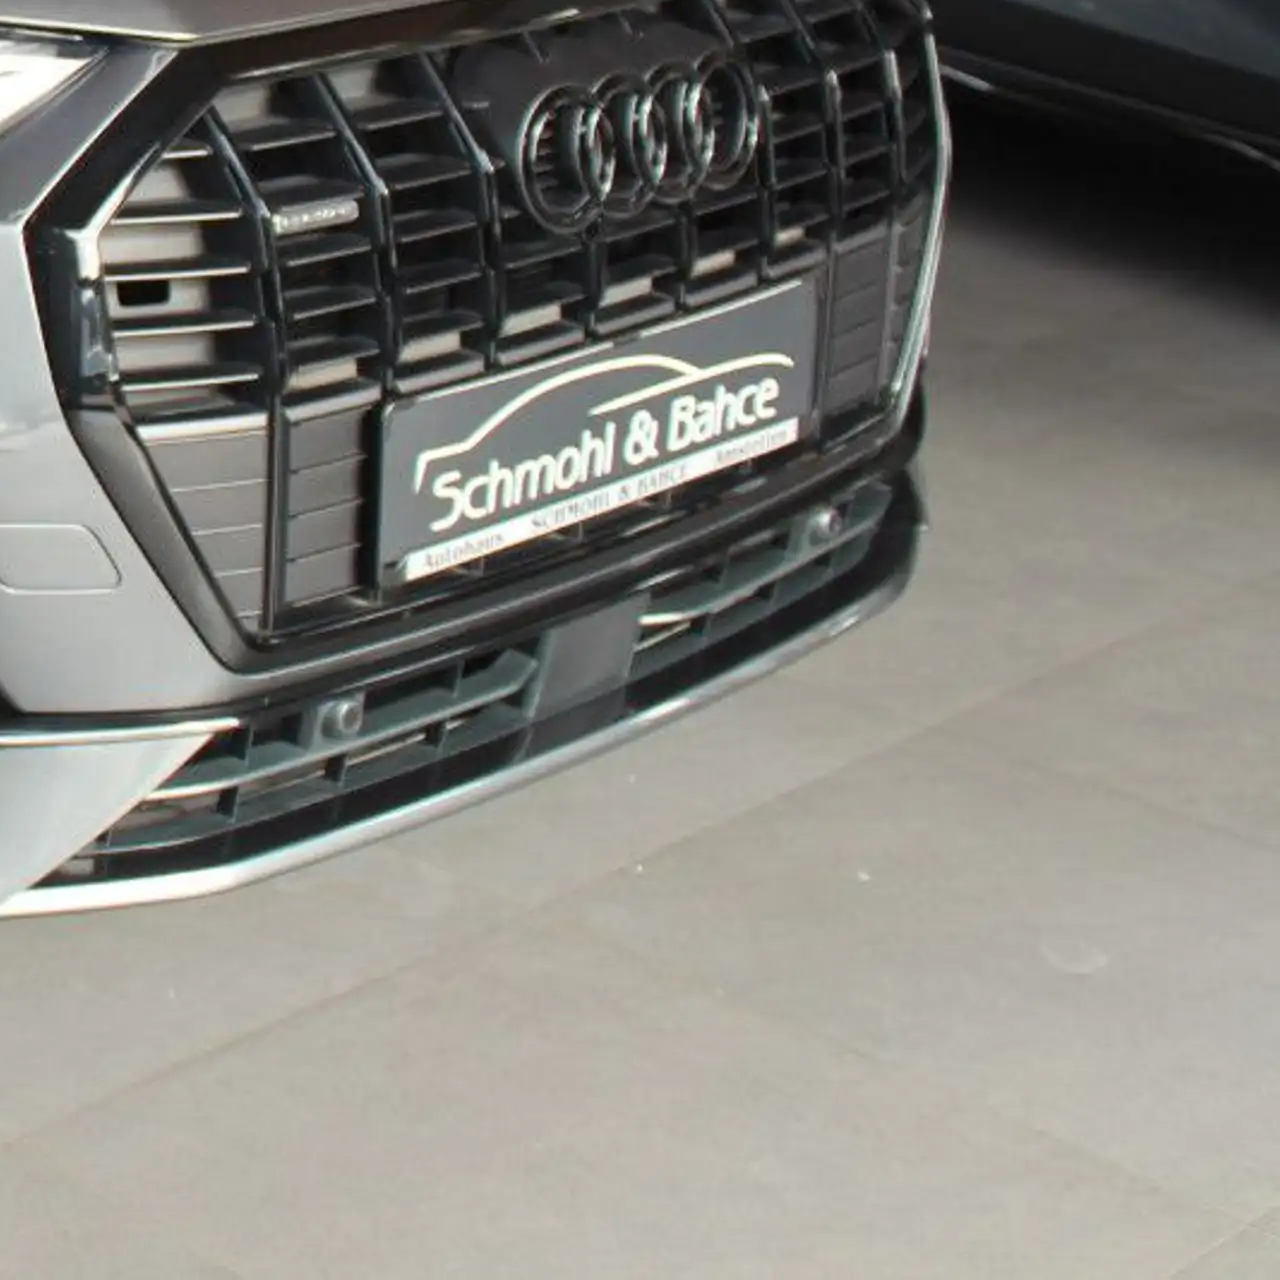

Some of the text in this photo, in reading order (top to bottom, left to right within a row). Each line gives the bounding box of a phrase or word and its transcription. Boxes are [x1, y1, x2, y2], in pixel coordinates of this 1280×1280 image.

[429, 377, 780, 532] Schmohl & Bahce
